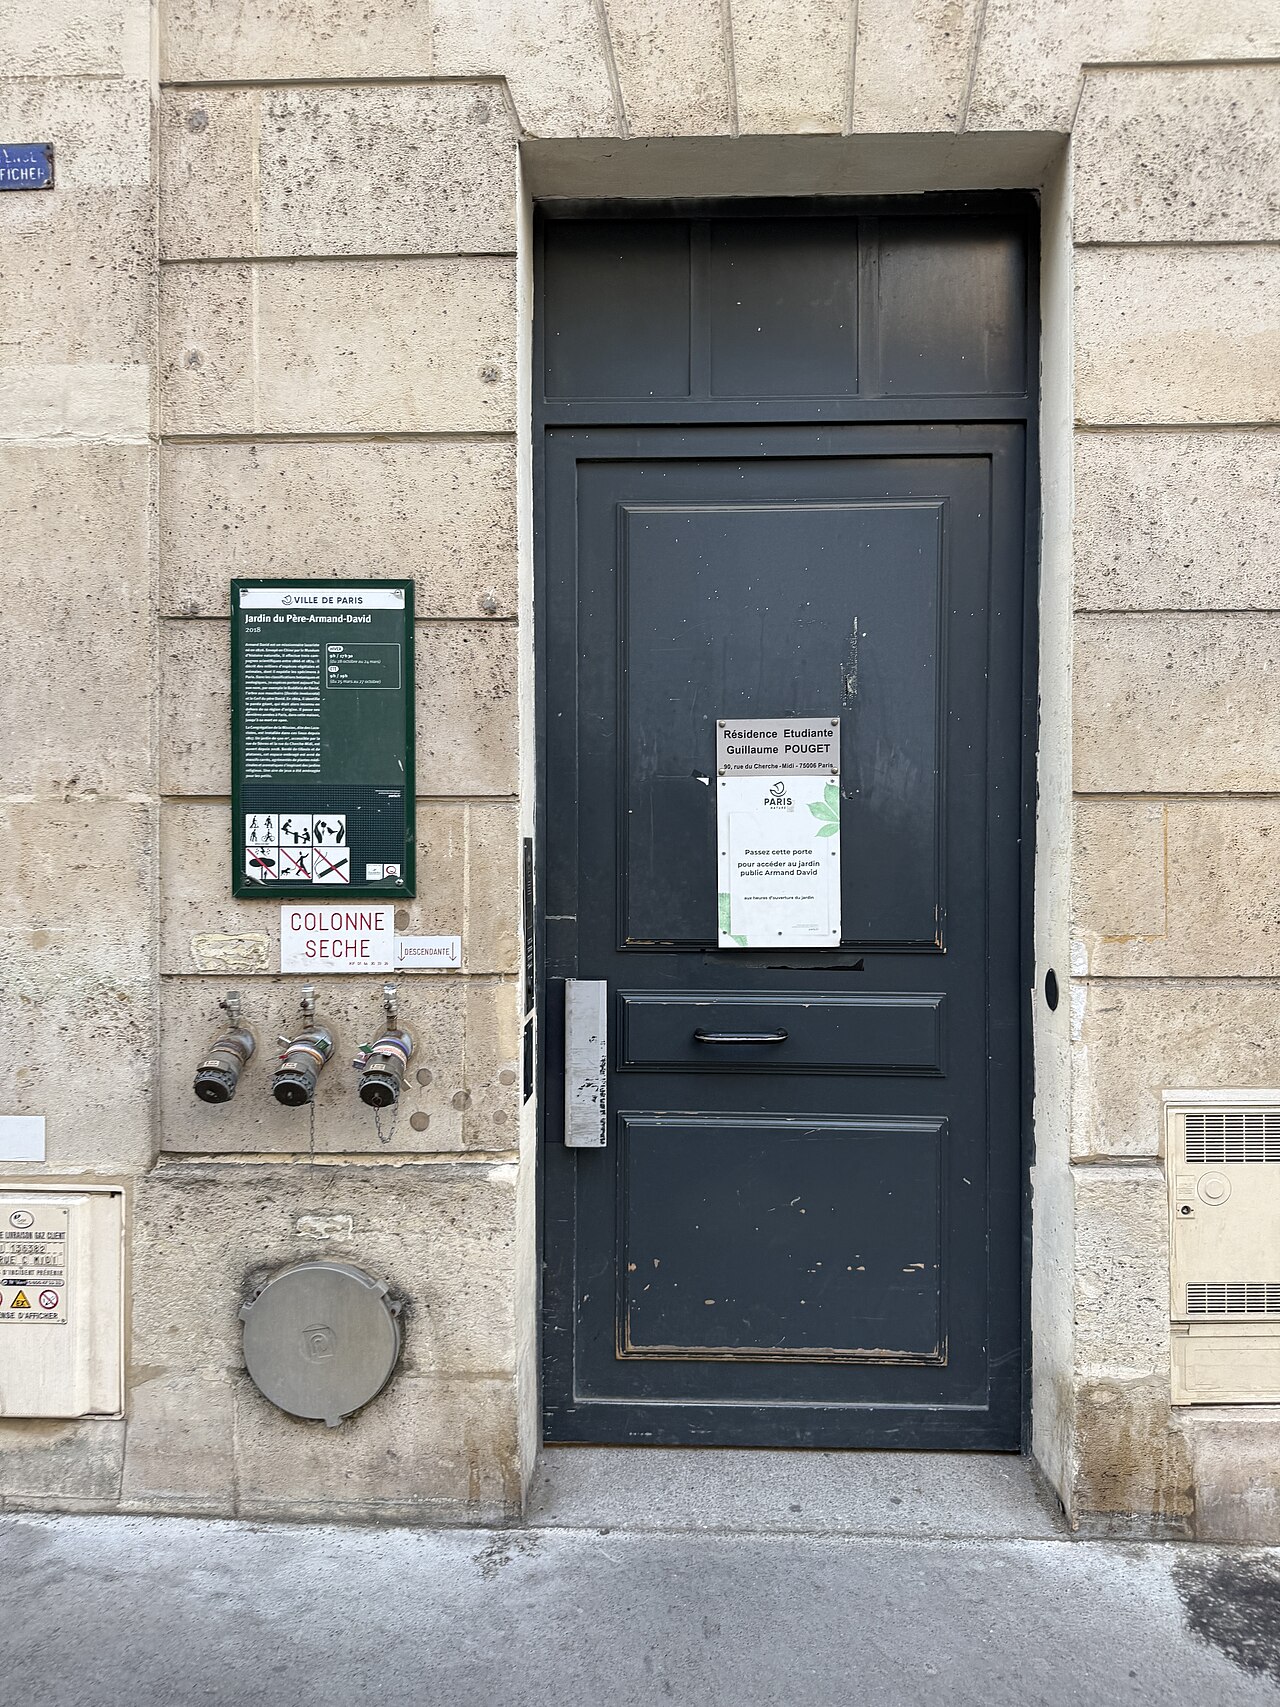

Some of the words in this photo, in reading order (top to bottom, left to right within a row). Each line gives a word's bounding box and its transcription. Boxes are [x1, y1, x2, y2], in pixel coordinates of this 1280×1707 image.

[293, 596, 319, 604] VILLE
[322, 596, 334, 604] DE
[336, 596, 363, 604] PARIS
[245, 614, 271, 623] Jardin
[273, 614, 285, 623] du
[286, 614, 372, 623] Père-Armand-David
[723, 729, 778, 739] Résidence
[783, 729, 834, 738] Etudiante
[726, 745, 779, 754] Guillaume
[784, 744, 831, 754] POUGET
[764, 797, 793, 806] PARIS
[798, 860, 820, 868] jardin
[740, 869, 763, 877] public
[291, 912, 385, 931] COLONNE
[305, 939, 370, 958] SECHE
[404, 947, 450, 956] DESCENDANTE
[46, 1231, 66, 1239] CLIENT
